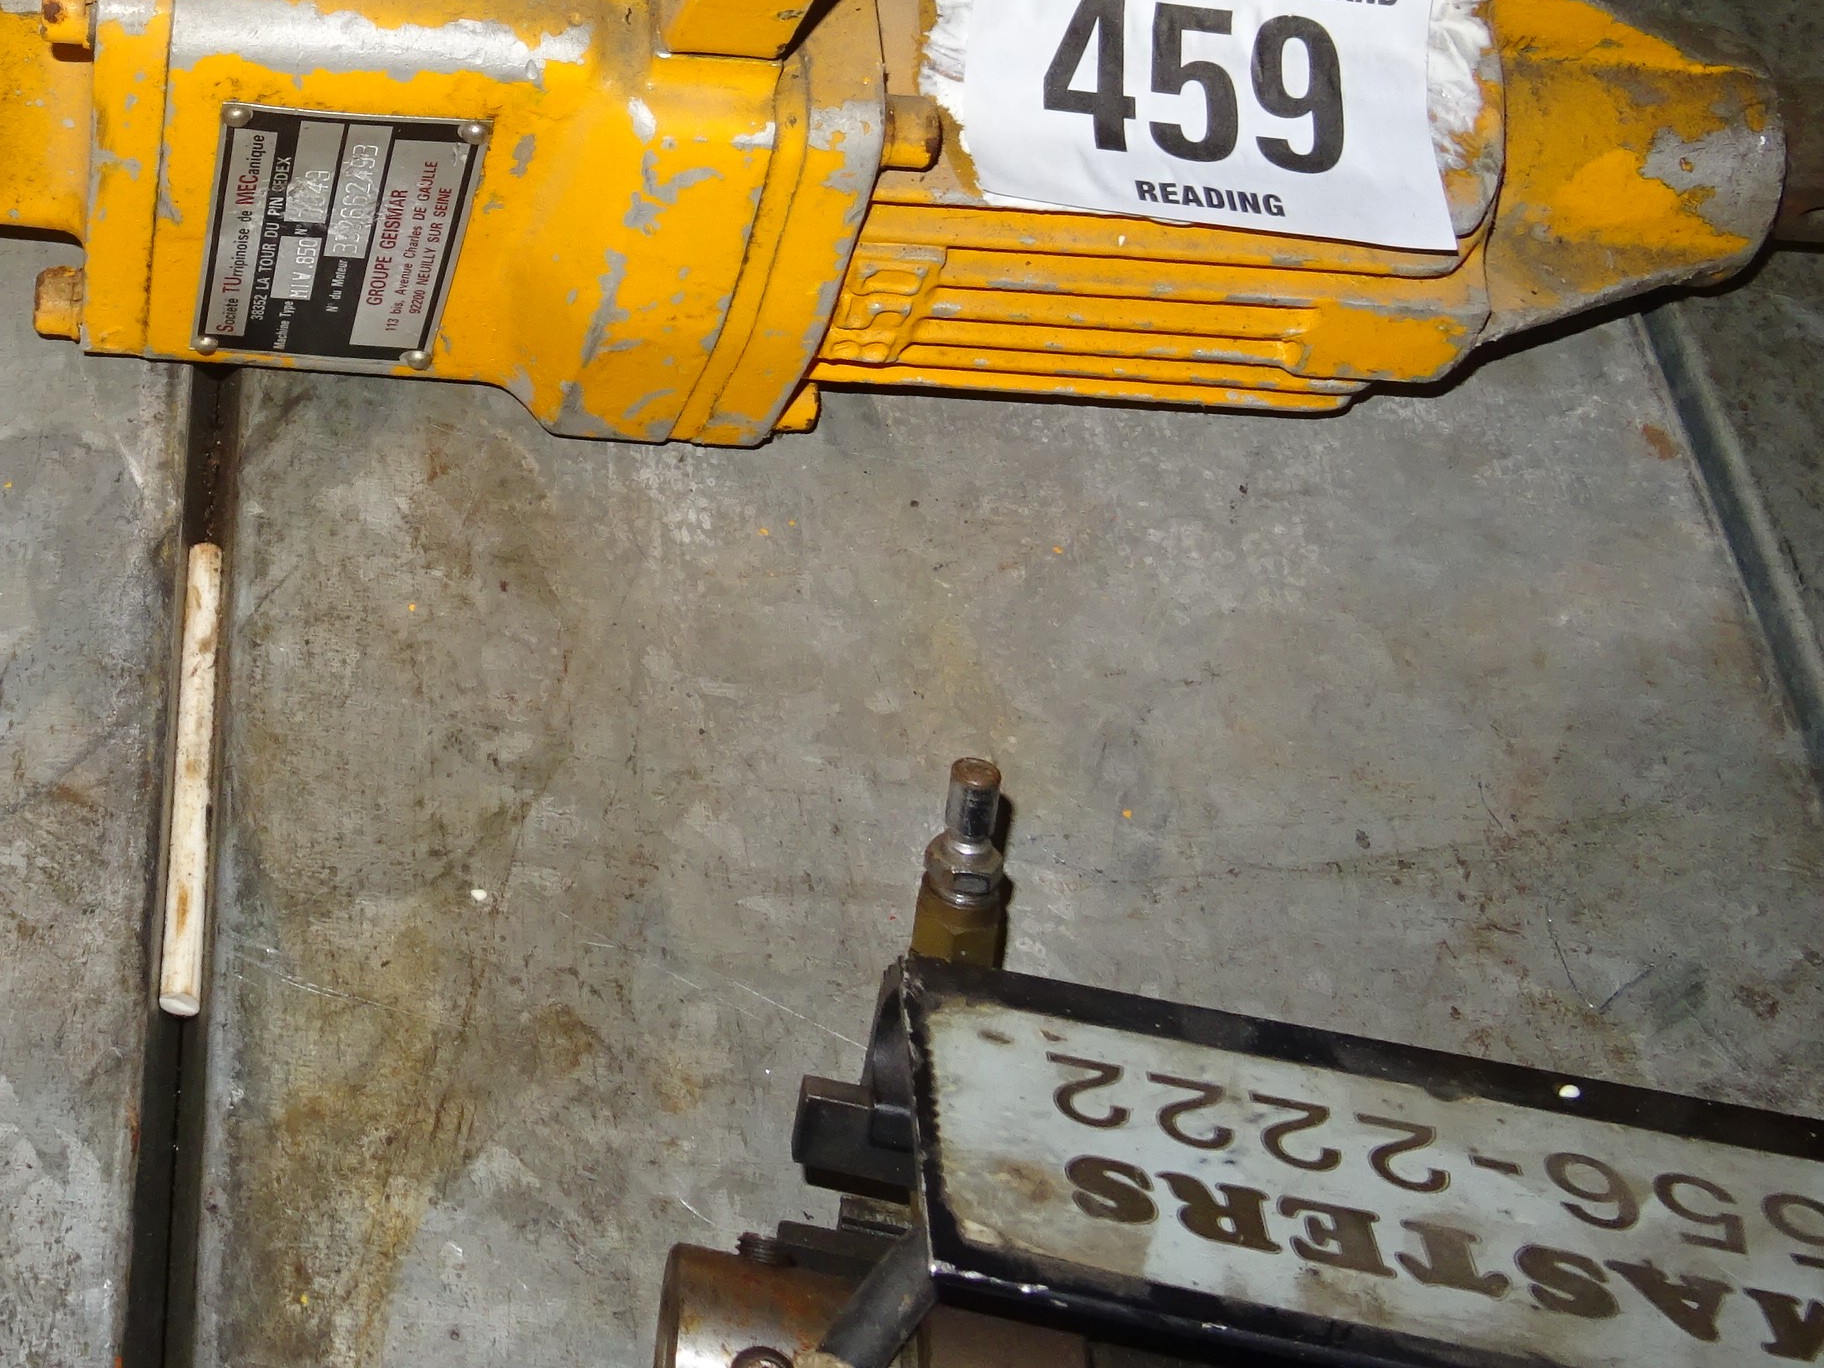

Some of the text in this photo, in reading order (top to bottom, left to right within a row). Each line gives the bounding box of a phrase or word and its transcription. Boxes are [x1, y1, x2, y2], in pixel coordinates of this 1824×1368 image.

[235, 134, 267, 205] MECanique
[418, 161, 438, 204] GAULLE
[412, 207, 426, 221] DE
[1134, 179, 1286, 218] READING
[237, 210, 253, 222] de
[251, 156, 292, 321] 38352 LA TOUR DU PIN CEDEX
[366, 189, 408, 306] GROUPE GEISMAR
[404, 225, 423, 259] Charles
[409, 188, 452, 314] 92200 NEUILLY SUR SEINE
[331, 259, 348, 287] Moteur
[395, 263, 413, 296] Avenue
[279, 300, 296, 318] Type
[329, 289, 342, 300] du
[273, 319, 291, 350] Machine
[385, 319, 399, 332] 113
